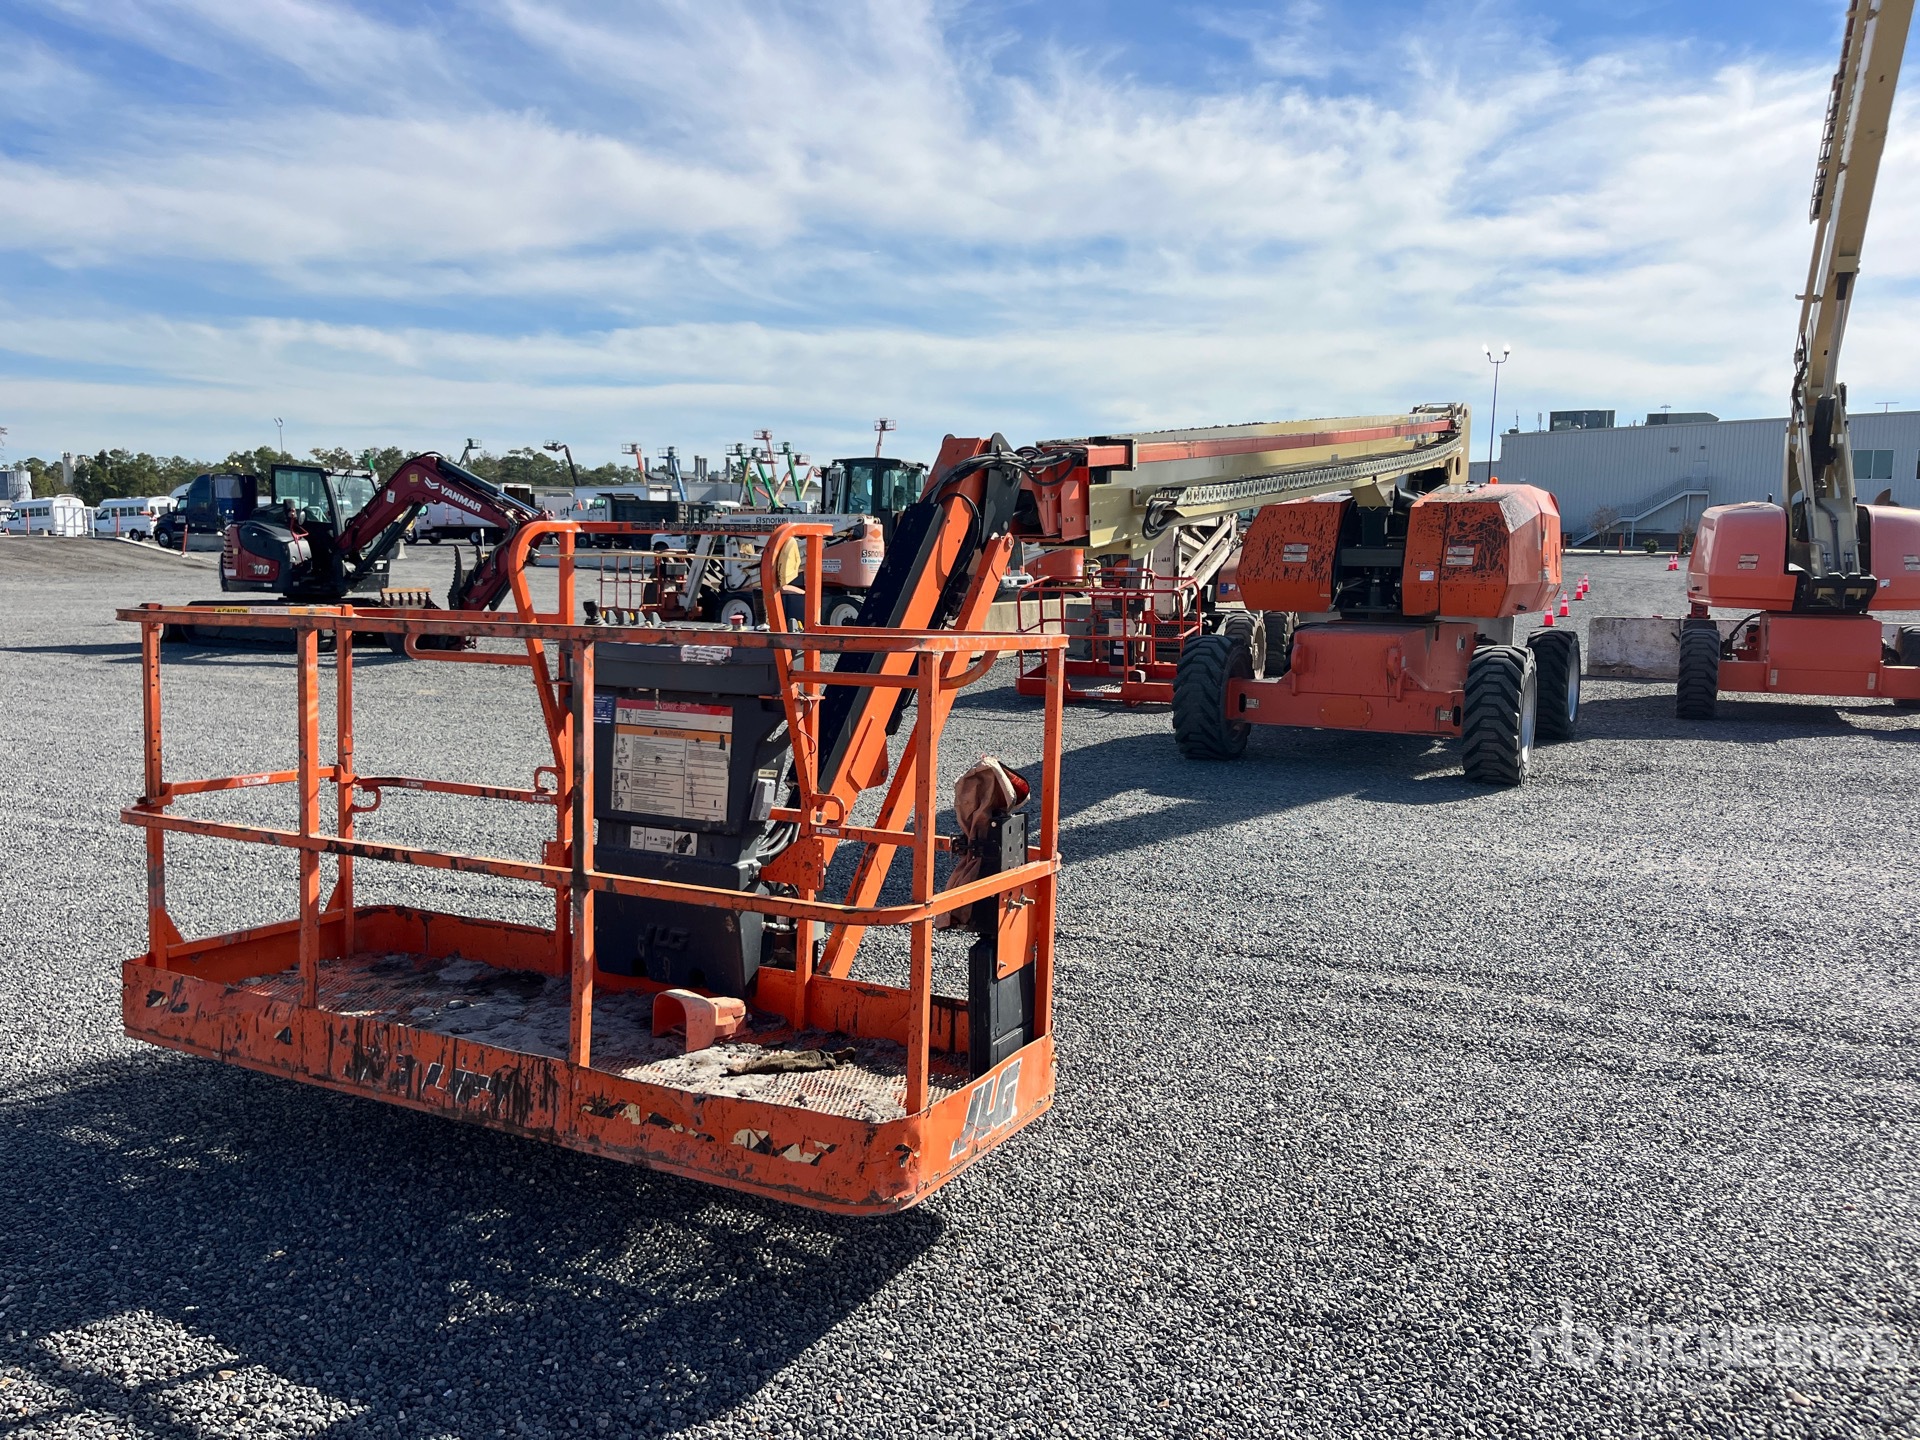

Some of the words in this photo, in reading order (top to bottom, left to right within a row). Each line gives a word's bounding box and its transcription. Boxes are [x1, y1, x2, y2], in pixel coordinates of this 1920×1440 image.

[440, 485, 482, 513] YANMAR
[253, 564, 270, 575] 100
[662, 703, 687, 712] DANGER
[658, 729, 687, 738] WARNING
[949, 1057, 1024, 1161] JLG
